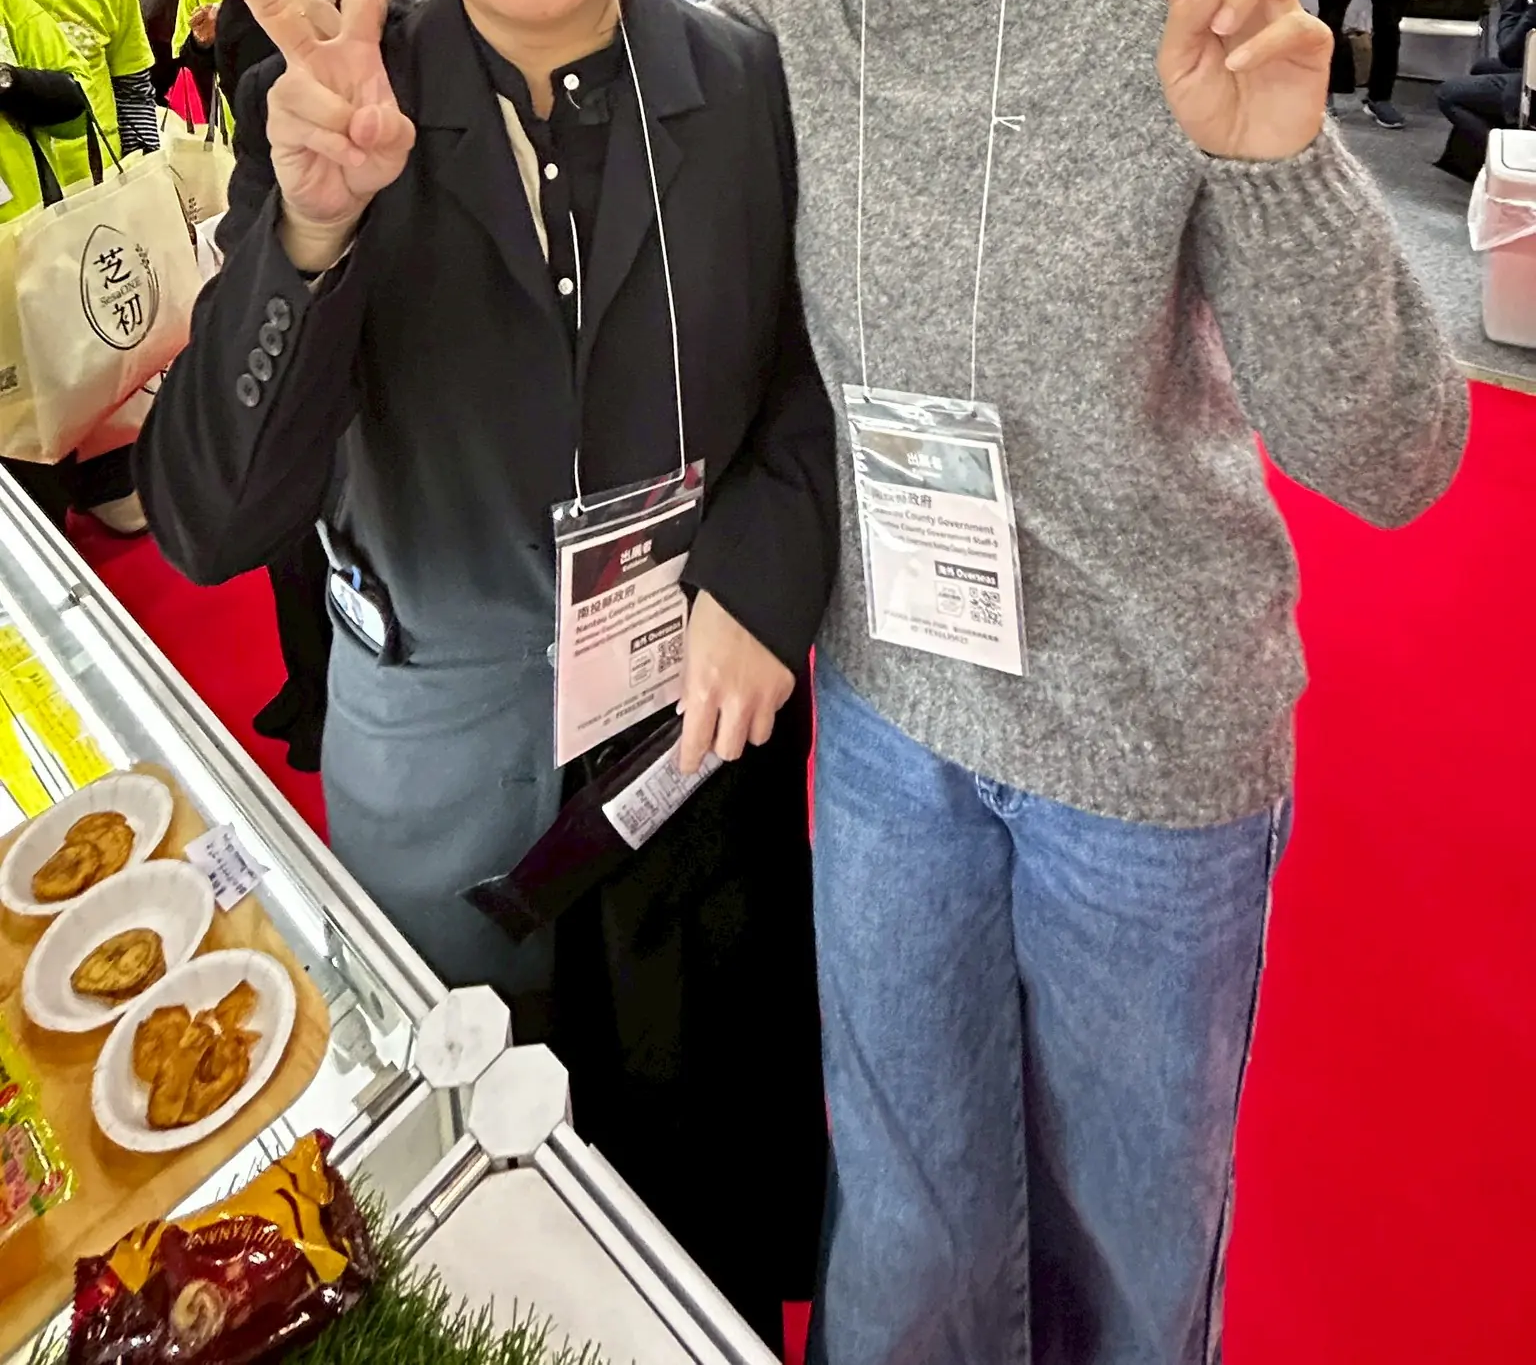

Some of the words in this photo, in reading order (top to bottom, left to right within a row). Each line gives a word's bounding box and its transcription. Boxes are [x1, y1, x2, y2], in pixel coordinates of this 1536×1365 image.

[93, 246, 132, 290] 芝
[112, 293, 143, 336] 初
[904, 509, 936, 526] County
[937, 516, 995, 535] Government
[956, 567, 996, 586] Overseas
